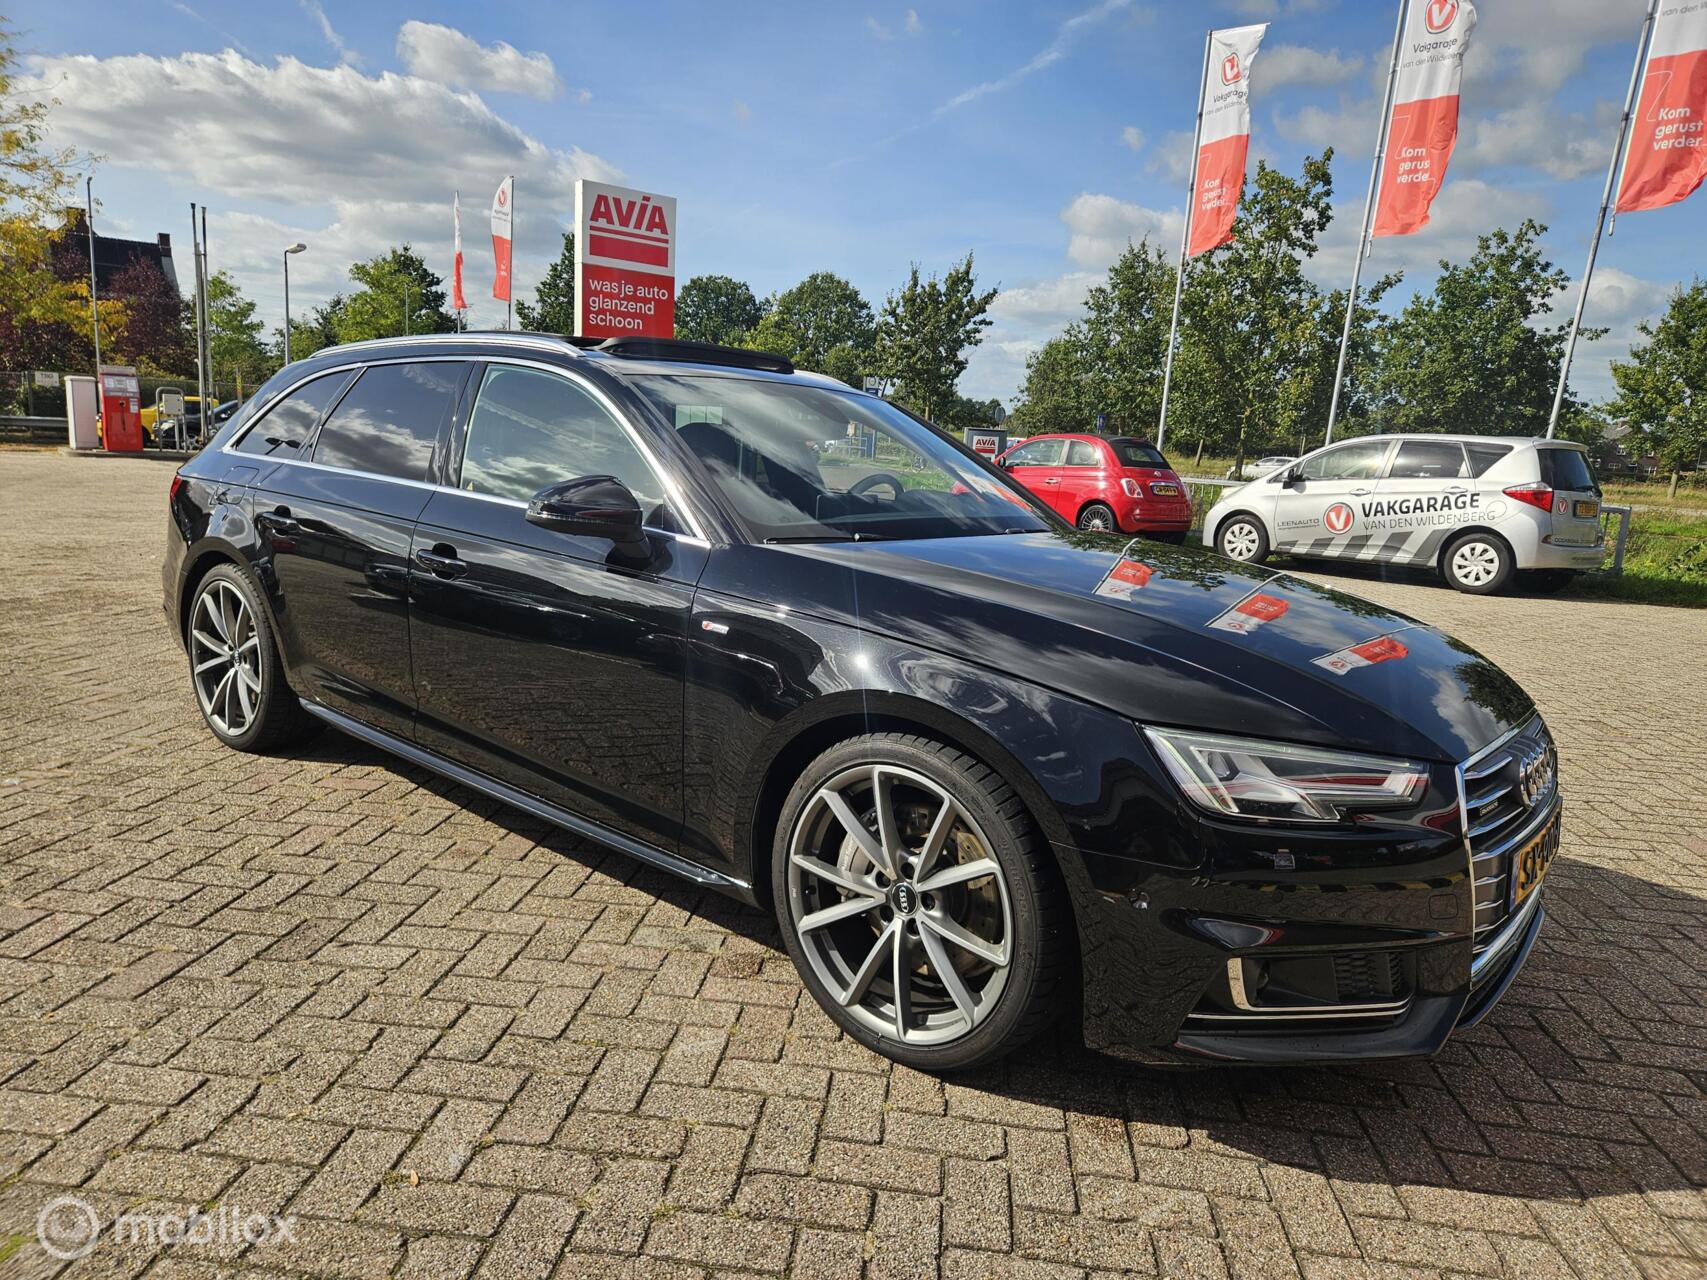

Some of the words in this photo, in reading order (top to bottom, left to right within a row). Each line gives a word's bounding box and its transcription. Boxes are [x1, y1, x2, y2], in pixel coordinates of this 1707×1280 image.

[1659, 107, 1690, 121] Kom
[1655, 120, 1704, 139] gerust
[1653, 135, 1703, 150] verder
[1399, 160, 1431, 174] gerus
[1397, 170, 1430, 184] verde
[589, 279, 619, 293] was
[620, 280, 633, 297] je
[636, 285, 668, 300] auto
[589, 294, 655, 315] glanzend
[588, 312, 643, 330] schoon
[1361, 493, 1481, 518] VAKGARAGE
[1363, 520, 1386, 531] VAN
[1389, 517, 1413, 529] DEN
[1416, 510, 1496, 527] WILDENBERG
